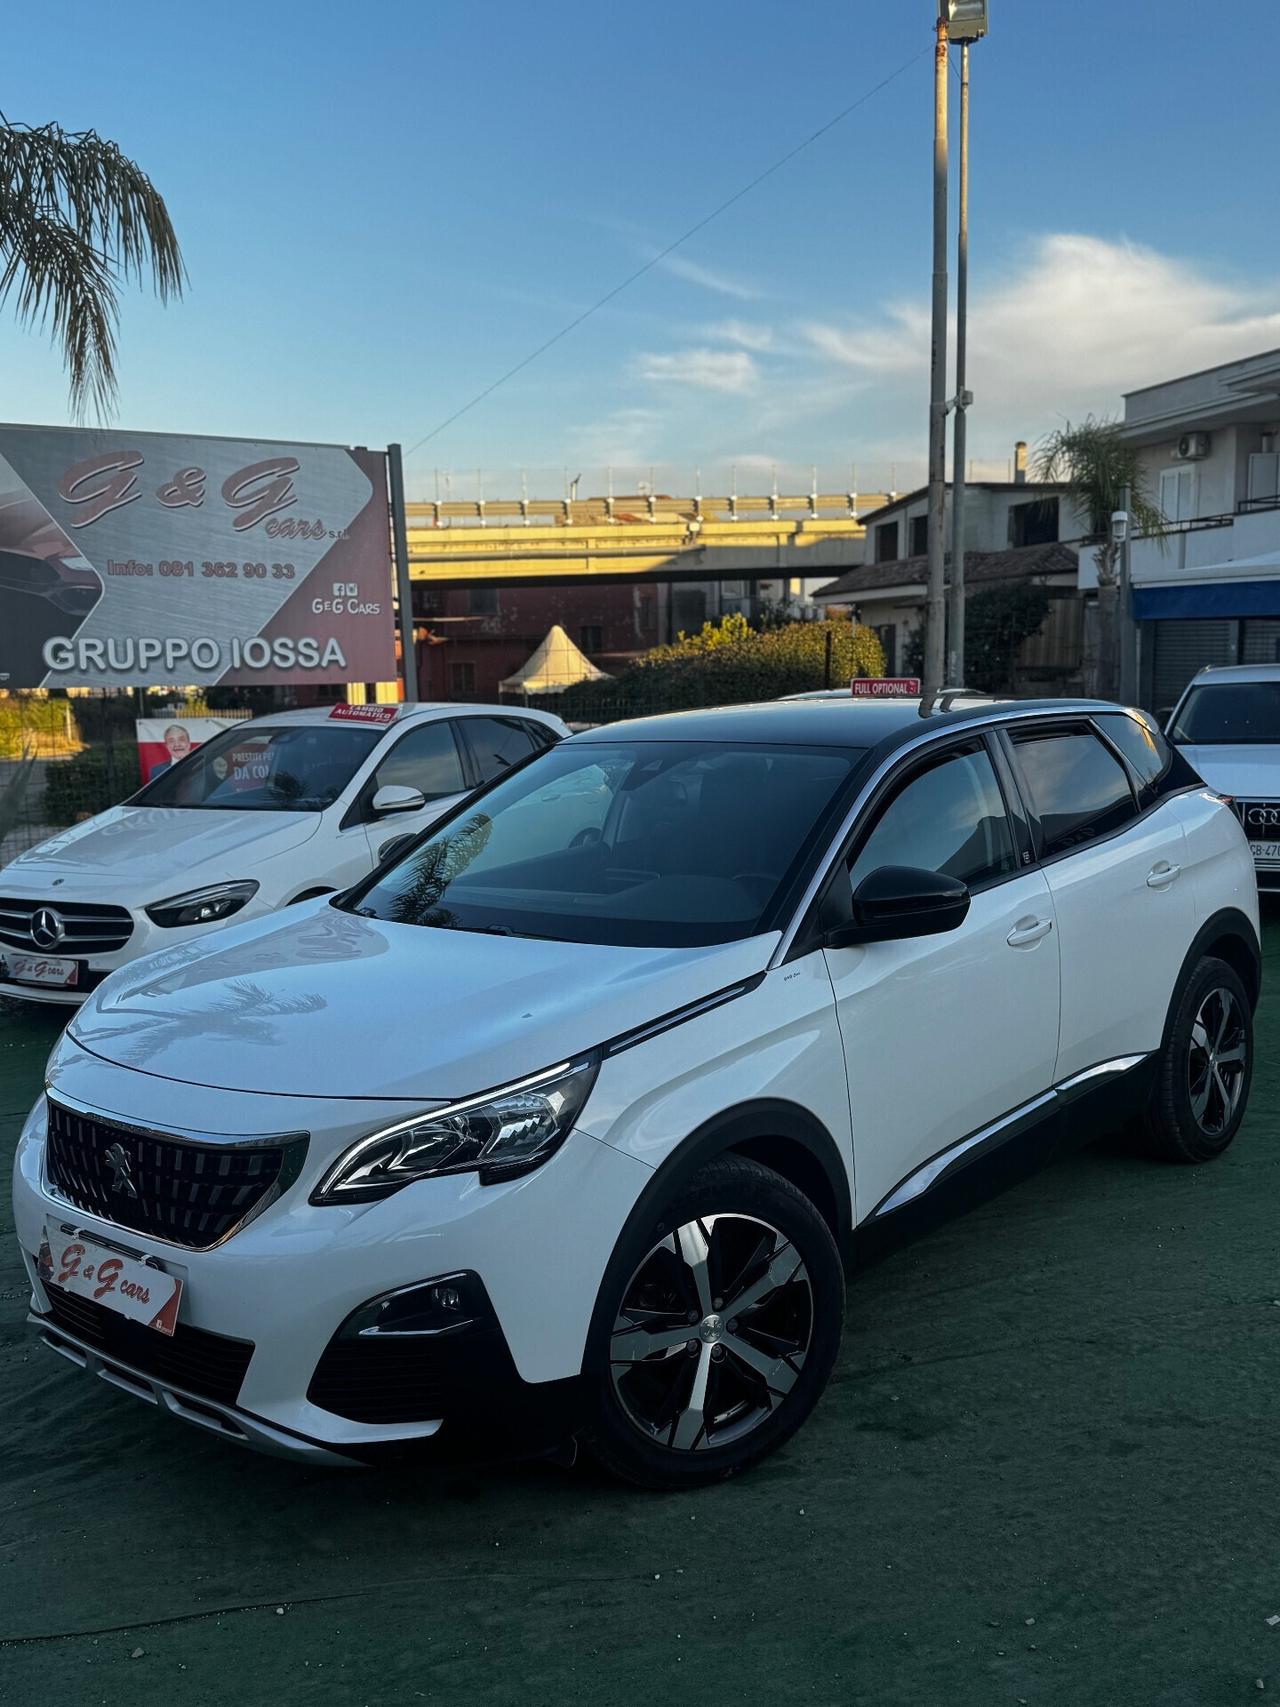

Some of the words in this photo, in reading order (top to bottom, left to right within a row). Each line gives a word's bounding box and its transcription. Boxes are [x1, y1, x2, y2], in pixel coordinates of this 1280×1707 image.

[59, 450, 145, 528] G
[155, 466, 207, 508] &
[221, 456, 300, 532] G
[265, 518, 327, 540] cars
[107, 559, 153, 577] Info:
[159, 560, 195, 578] 081
[201, 561, 238, 579] 362
[243, 562, 268, 579] 90
[271, 563, 296, 580] 33
[42, 635, 220, 671] GRUPPO
[231, 636, 347, 670] IOSSA
[854, 683, 871, 694] FULL
[872, 682, 908, 694] OPTIONAL
[335, 708, 392, 719] AUTOMATICO
[58, 1244, 86, 1282] G
[83, 1264, 95, 1281] &
[94, 1258, 124, 1300] G
[120, 1279, 150, 1305] cars
